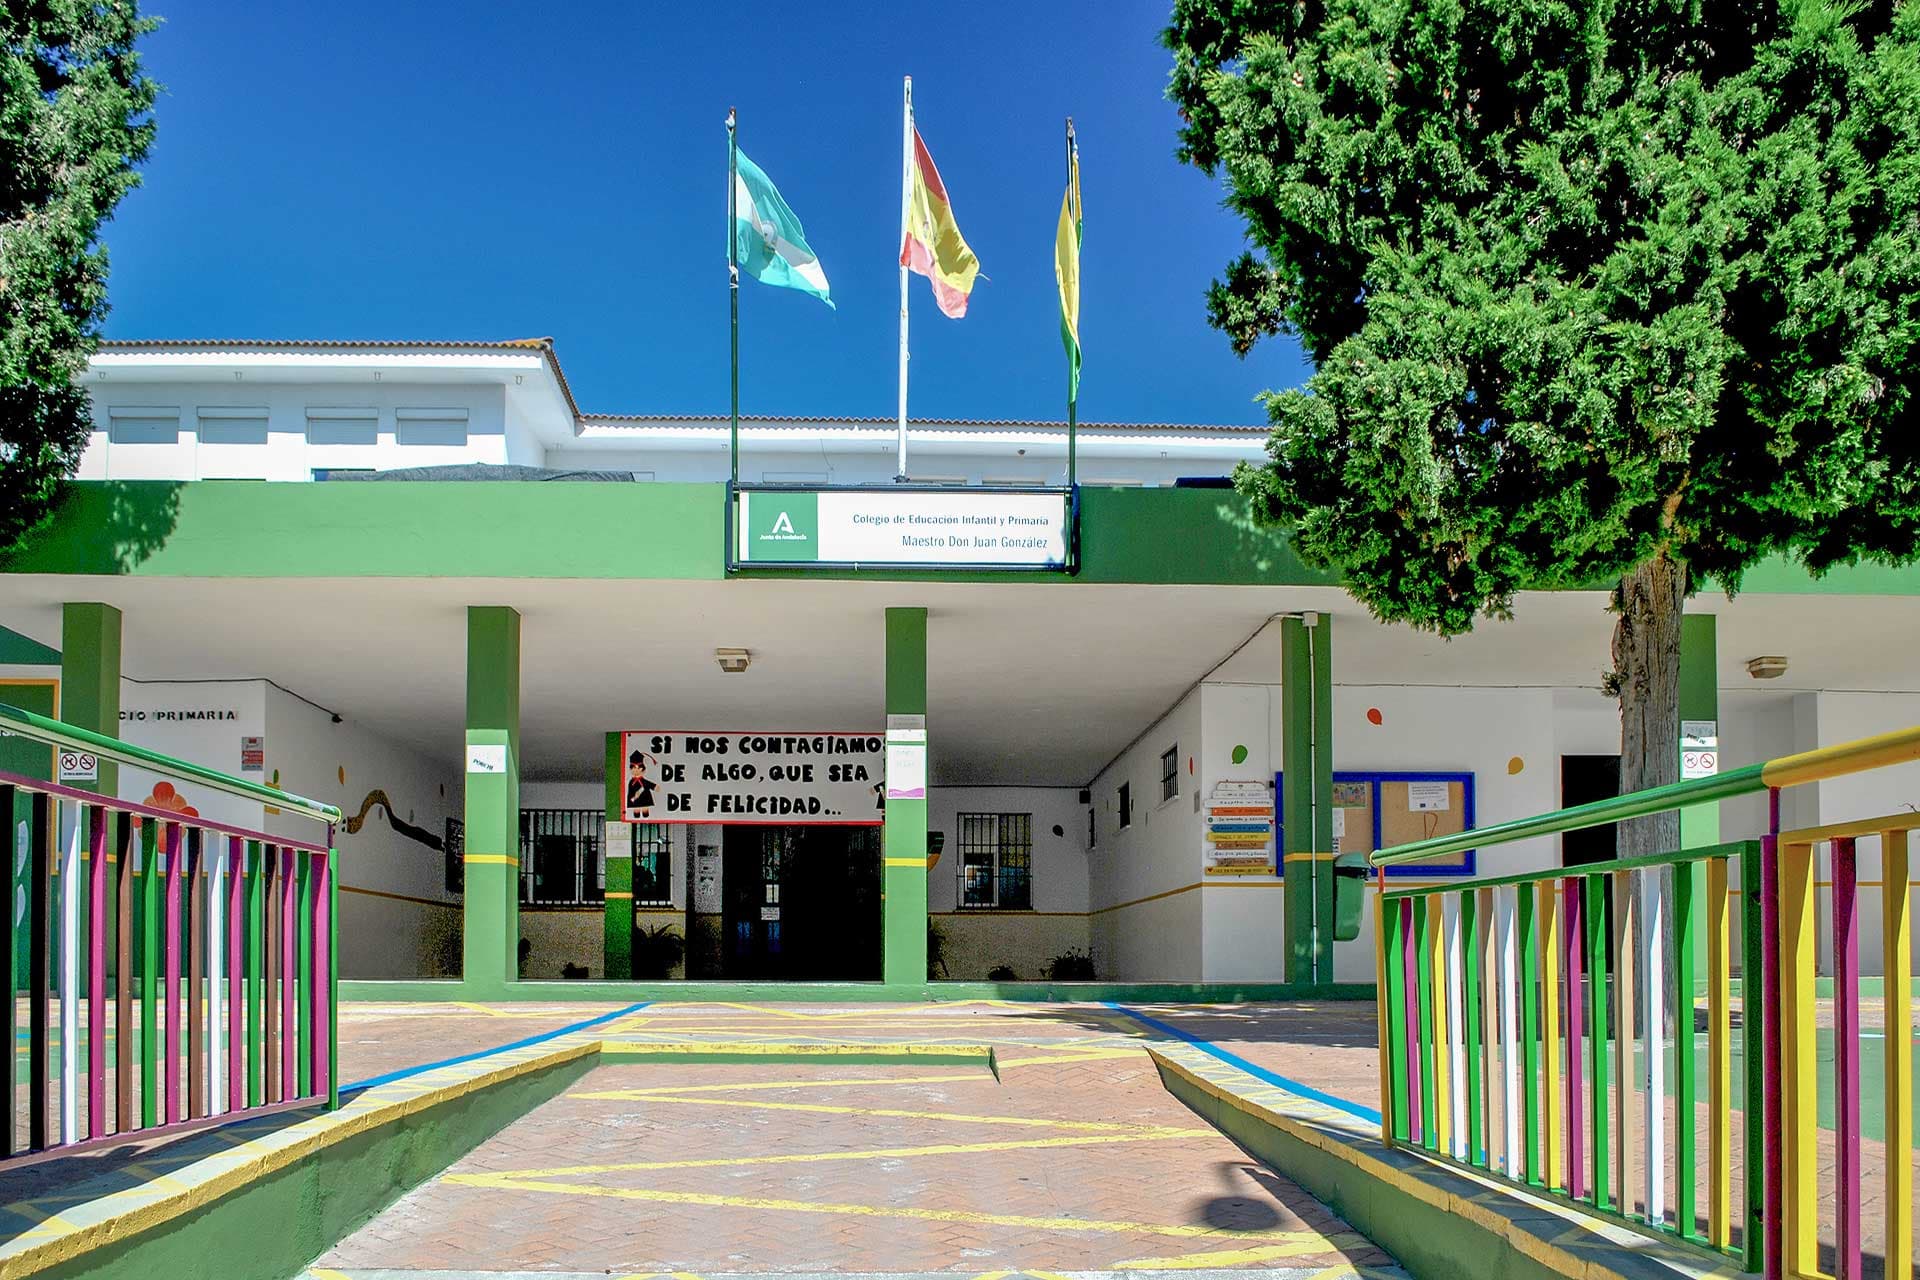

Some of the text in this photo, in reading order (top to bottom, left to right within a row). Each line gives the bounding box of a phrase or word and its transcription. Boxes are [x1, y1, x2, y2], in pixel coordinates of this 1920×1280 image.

[853, 514, 890, 526] Colegio
[893, 514, 905, 524] de
[962, 515, 997, 525] Infantil
[1000, 518, 1005, 526] y
[1008, 516, 1049, 526] Primaria
[902, 535, 1048, 549] Maestro Don Juan González
[157, 710, 236, 720] PRIMARIA
[685, 736, 729, 754] NOS
[739, 735, 886, 755] CONTAGIAMO
[661, 763, 869, 783] DE ALGO, QUE SEA
[667, 793, 691, 812] DE
